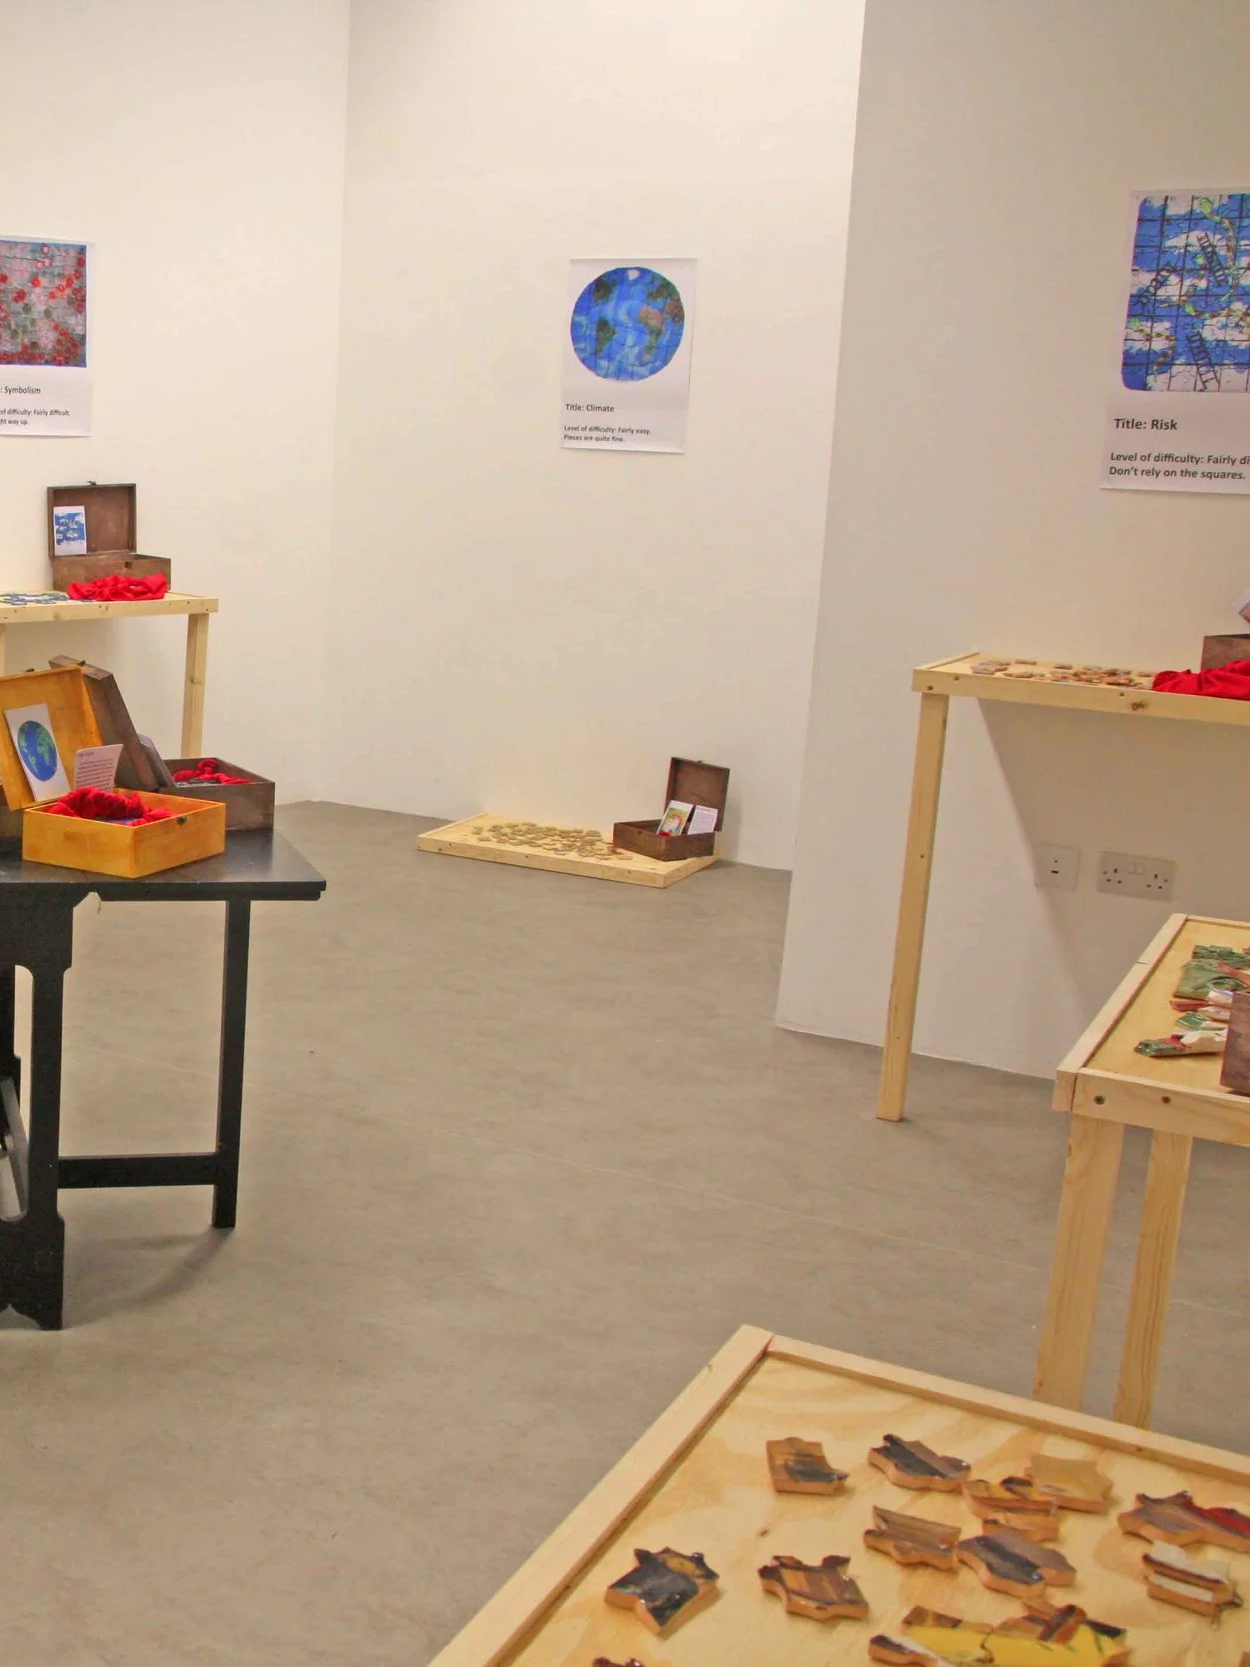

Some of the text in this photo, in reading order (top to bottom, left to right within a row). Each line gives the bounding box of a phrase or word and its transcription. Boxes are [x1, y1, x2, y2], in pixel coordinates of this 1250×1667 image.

[4, 386, 41, 395] Symbolism
[586, 404, 614, 412] Climate
[1114, 418, 1178, 430] Title: Risk
[1110, 452, 1138, 461] Level
[1140, 452, 1152, 462] of
[1153, 453, 1204, 465] difficulty:
[1207, 455, 1237, 466] Fairly
[1109, 466, 1138, 476] Don't
[1141, 467, 1160, 478] rely
[1180, 468, 1198, 478] the
[1201, 470, 1246, 480] squares.
